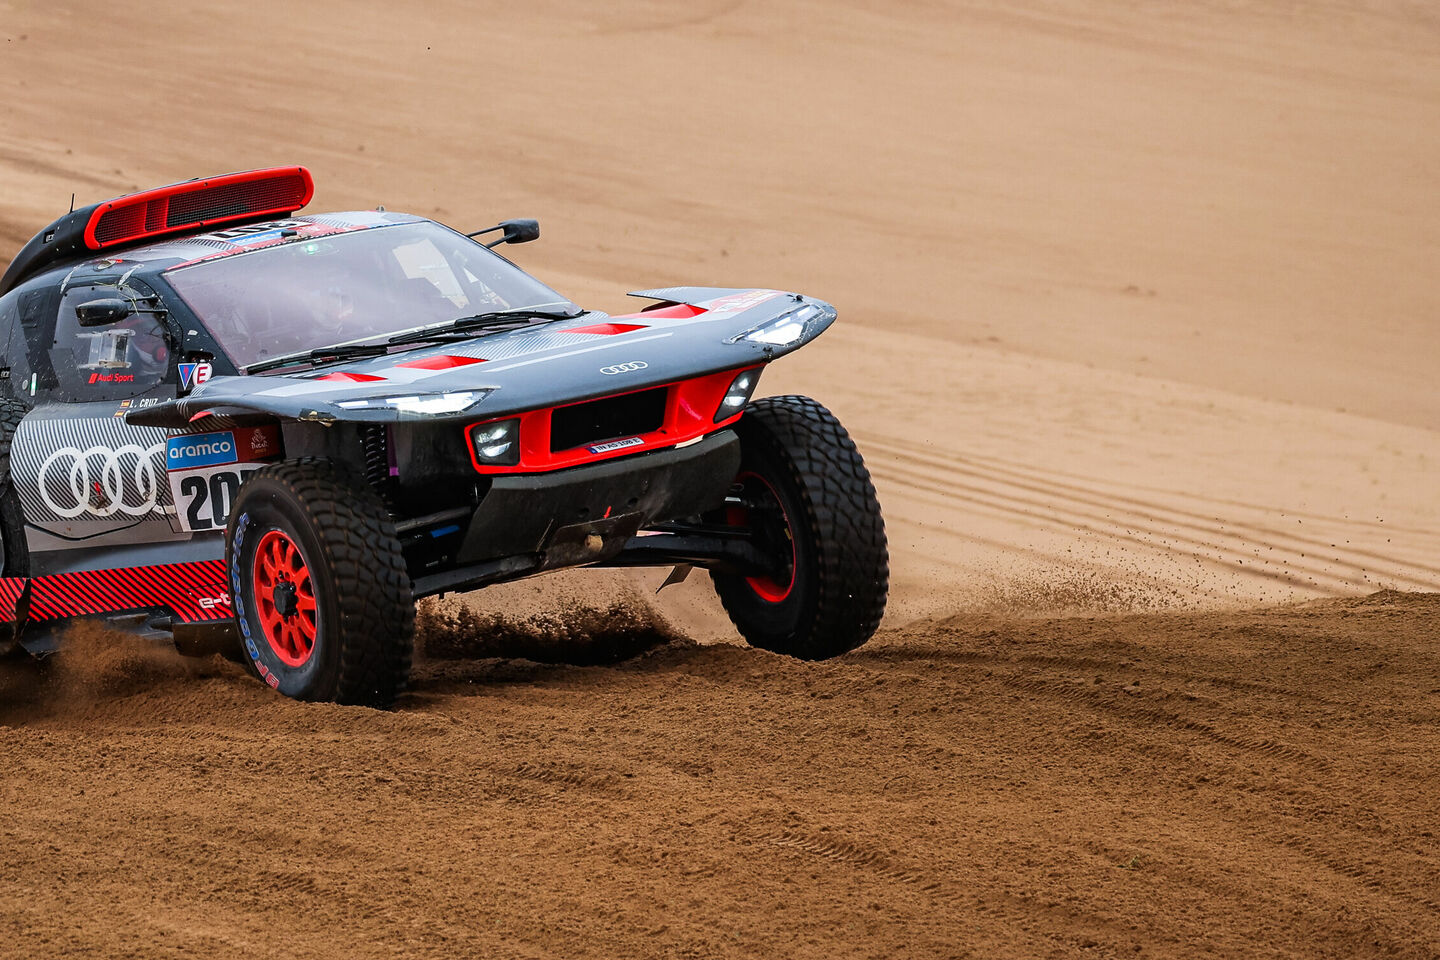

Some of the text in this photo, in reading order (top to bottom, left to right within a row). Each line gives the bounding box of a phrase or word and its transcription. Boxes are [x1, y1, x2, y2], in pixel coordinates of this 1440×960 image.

[97, 372, 135, 384] Audi Sport
[196, 366, 209, 384] E
[139, 397, 159, 408] CRUZ
[169, 441, 231, 459] aramco
[180, 470, 256, 530] 20
